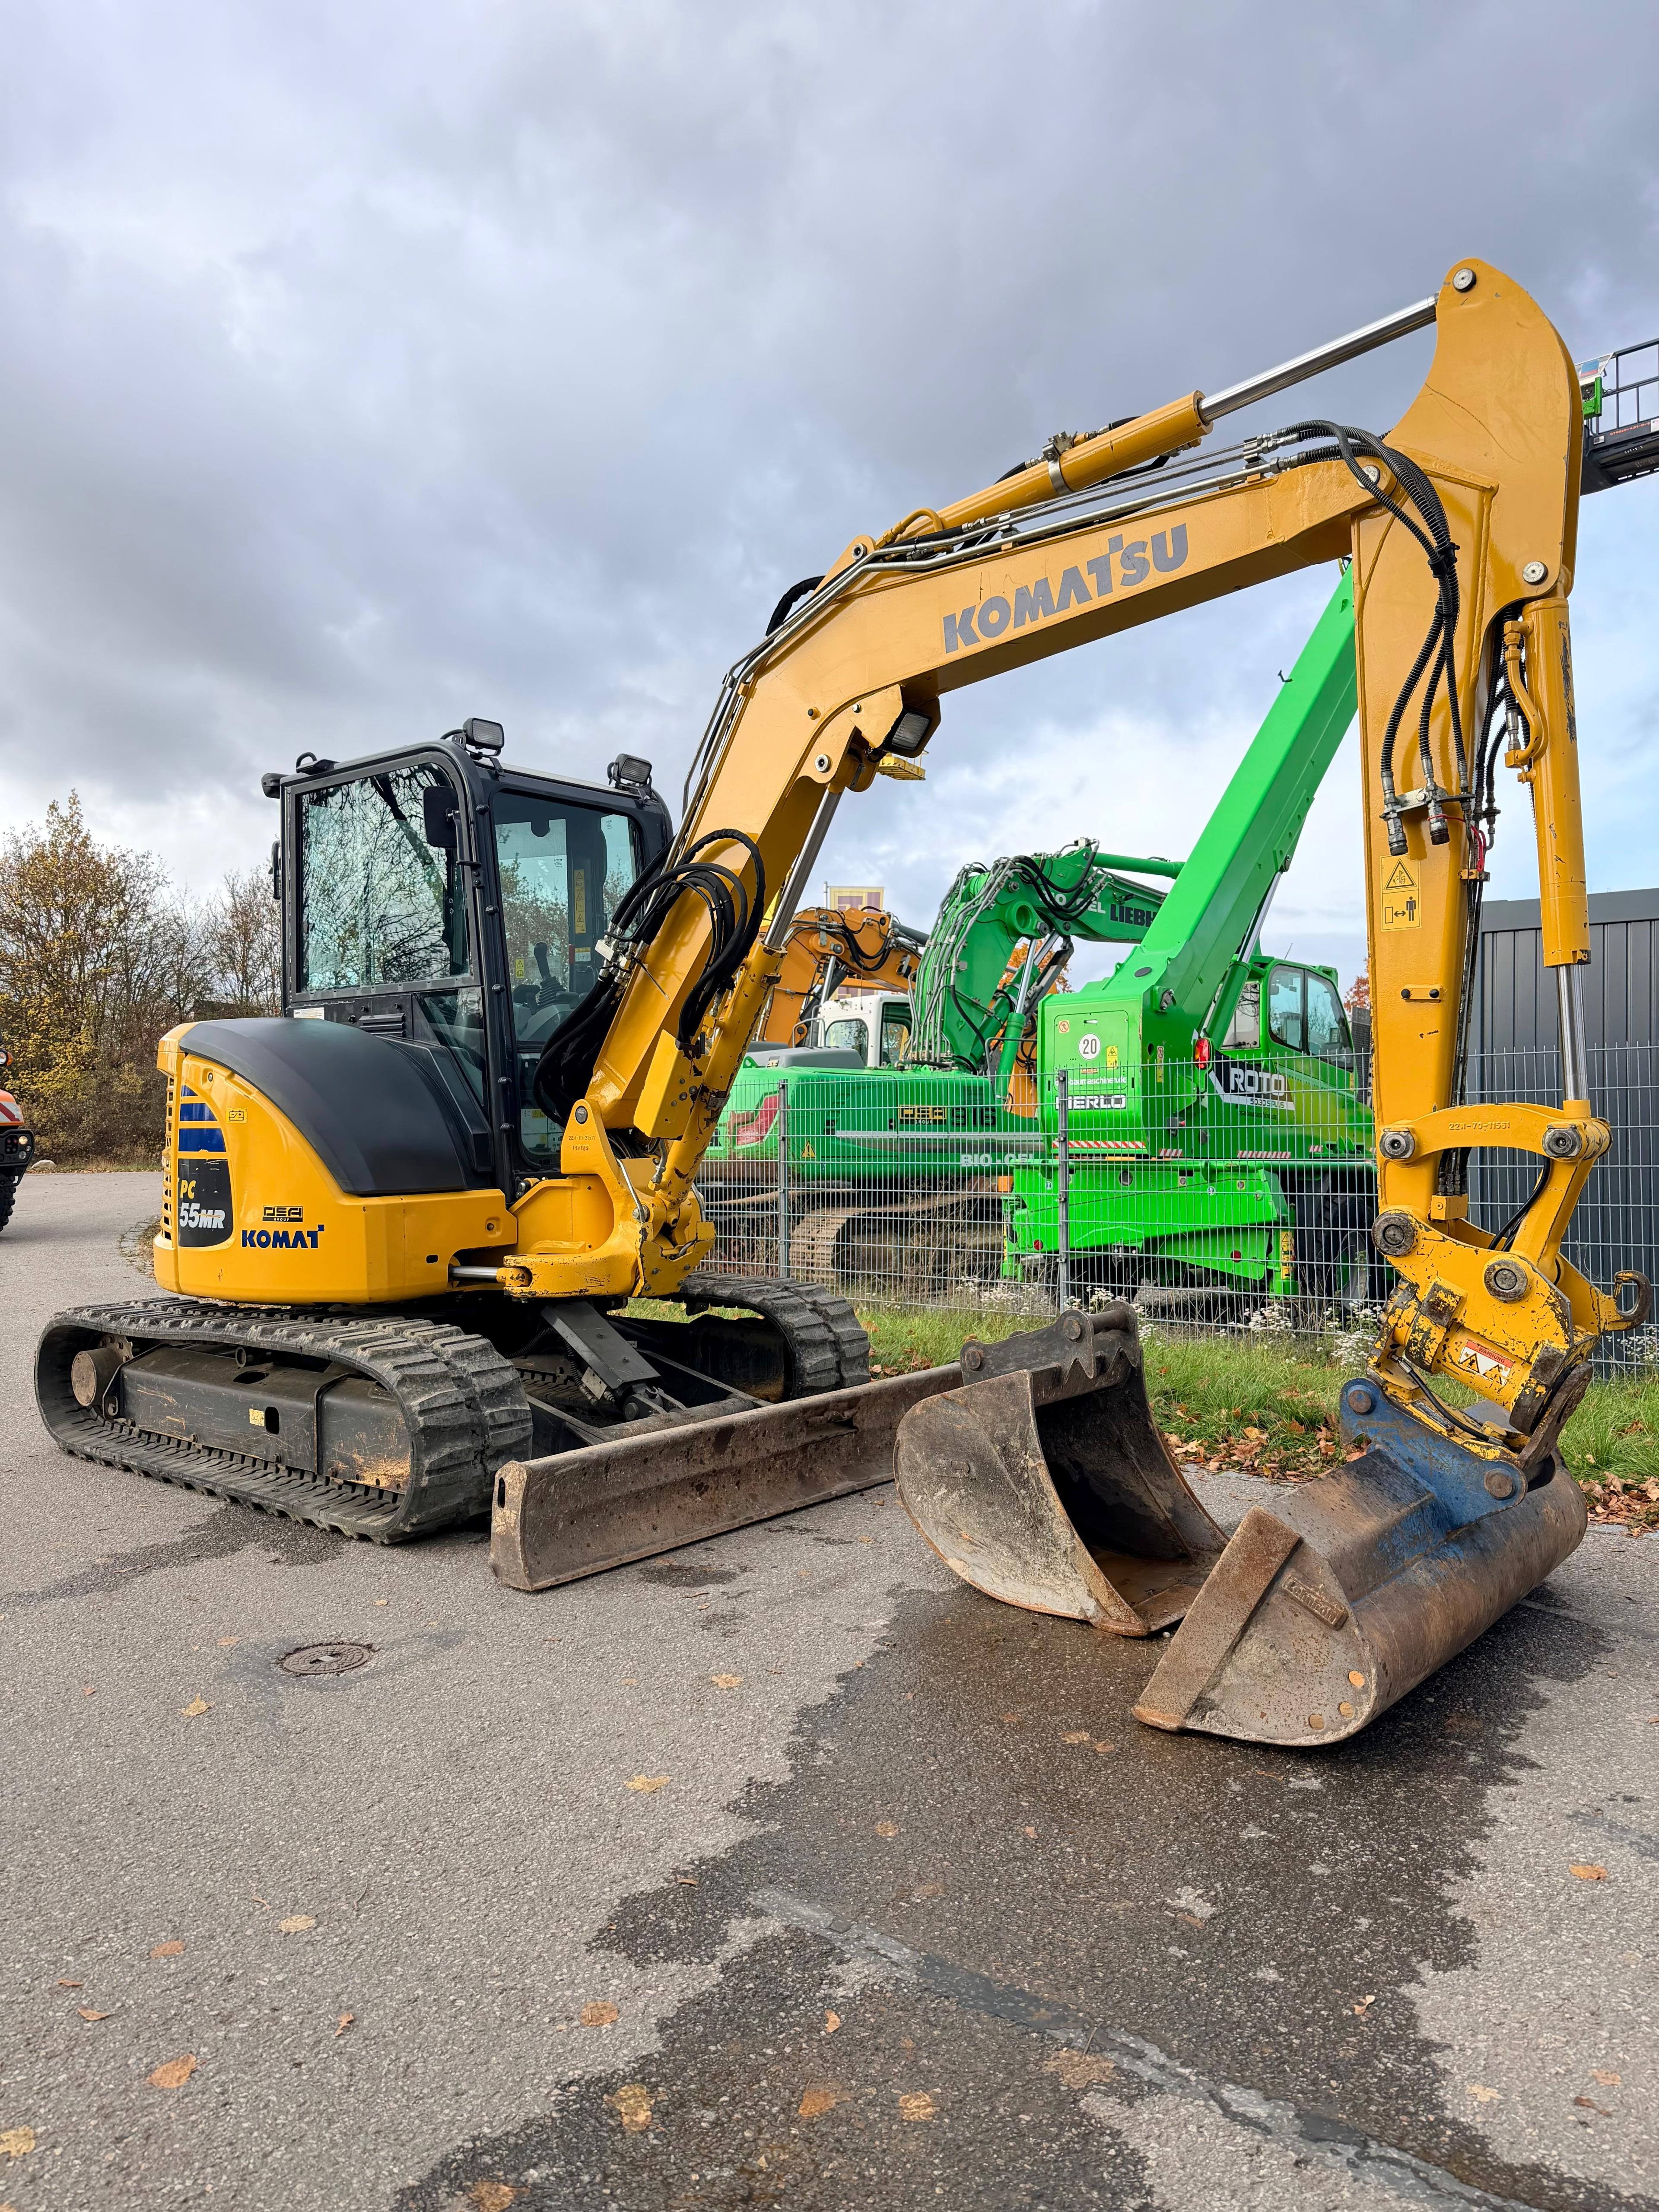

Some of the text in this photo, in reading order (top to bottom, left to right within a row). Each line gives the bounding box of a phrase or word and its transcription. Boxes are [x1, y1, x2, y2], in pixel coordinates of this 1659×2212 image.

[943, 523, 1189, 654] KOMATSU
[1083, 1038, 1097, 1055] 20
[1230, 1068, 1285, 1096] ROTO
[951, 1107, 996, 1126] 916
[180, 1179, 196, 1199] PC
[179, 1202, 225, 1229] 55MR
[242, 1224, 324, 1248] KOMAT
[1478, 1347, 1505, 1363] WARNUNG
